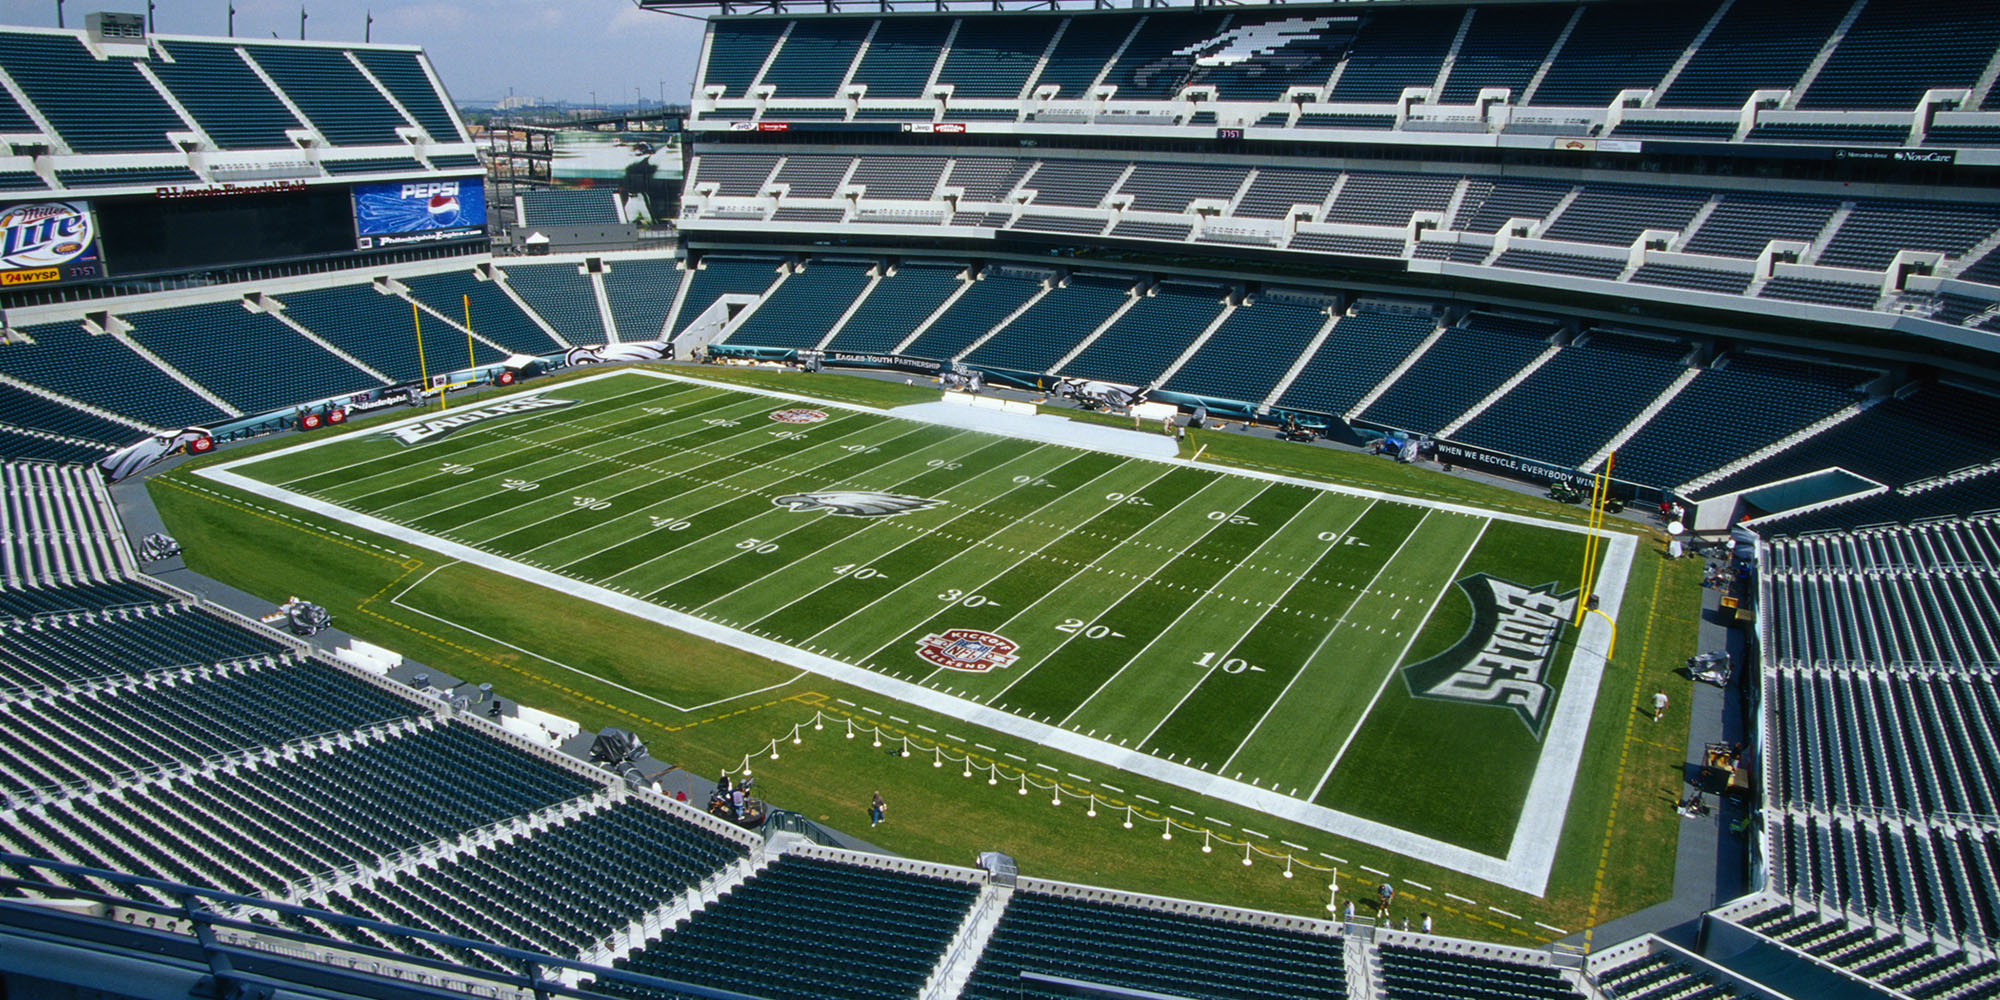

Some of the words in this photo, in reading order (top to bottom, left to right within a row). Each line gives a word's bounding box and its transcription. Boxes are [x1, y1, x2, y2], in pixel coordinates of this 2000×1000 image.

[1903, 151, 1951, 162] NovaCare
[170, 184, 222, 198] Lincoln
[278, 179, 306, 192] Field
[401, 181, 460, 200] PEPSI
[13, 207, 68, 221] Miller
[1, 215, 87, 258] Lite
[893, 356, 942, 370] PARTNERSHIP
[382, 394, 575, 444] EAGLES
[1438, 443, 1462, 457] WHEN
[1464, 450, 1478, 461] WE
[1479, 454, 1519, 472] RECYCLE,
[1521, 464, 1574, 484] EVERYBODY
[735, 538, 780, 555] 50
[832, 563, 878, 581] 40
[937, 588, 988, 609] 30
[1055, 618, 1111, 640] 20
[950, 631, 1013, 652] KICKOFF
[1421, 576, 1580, 722] EAGLES
[922, 648, 988, 671] WEEKEND
[945, 644, 979, 661] NFL
[1192, 651, 1248, 675] 10
